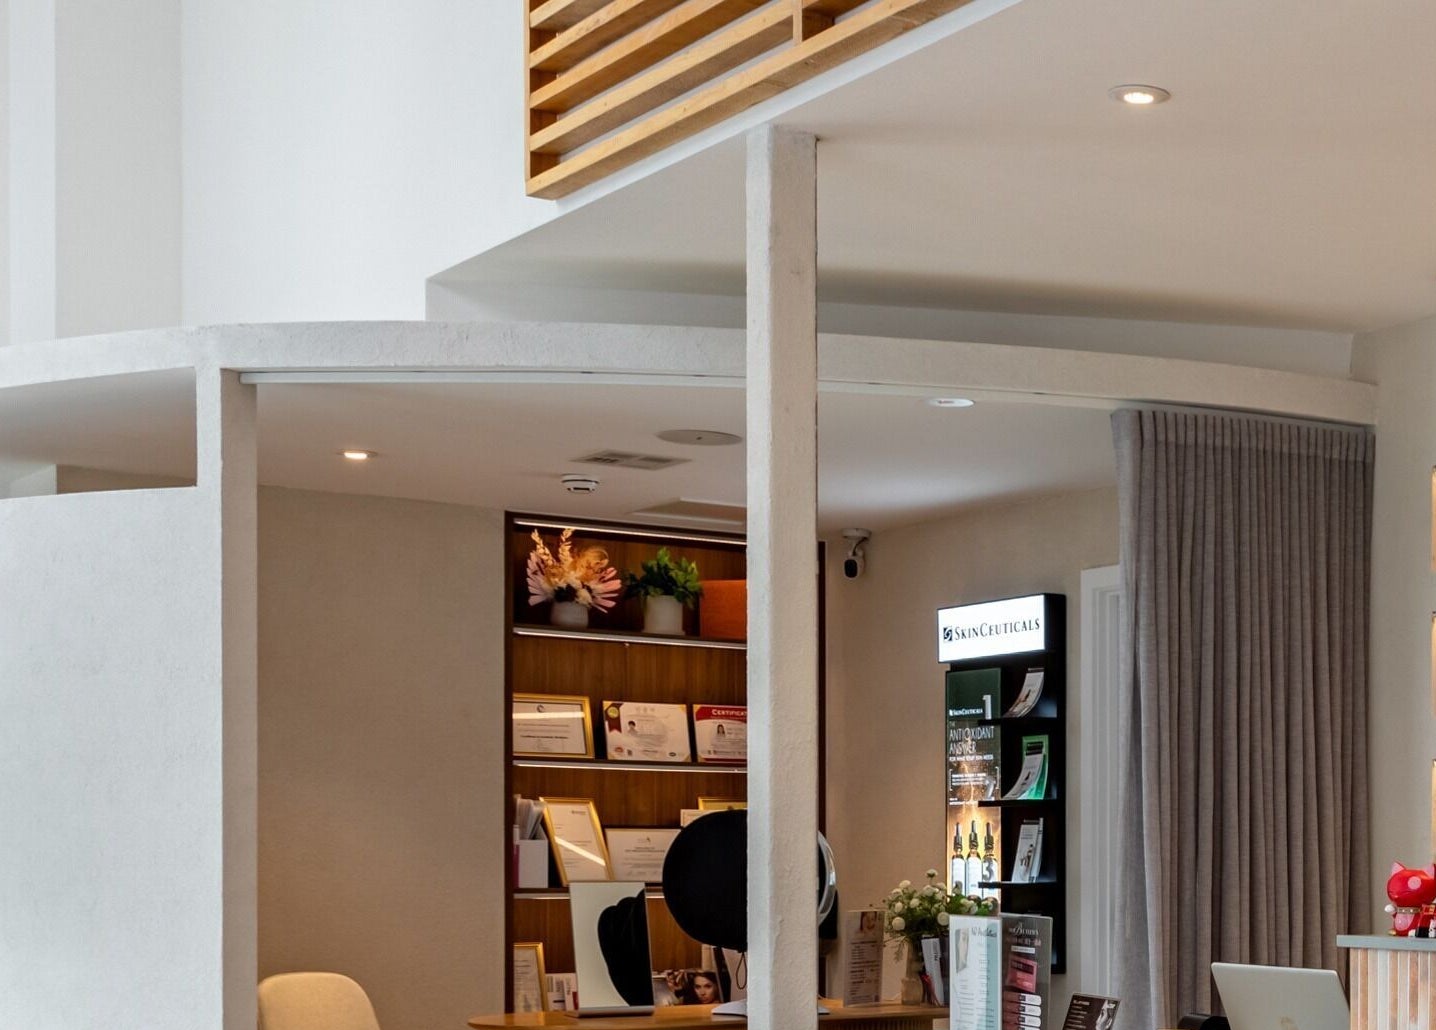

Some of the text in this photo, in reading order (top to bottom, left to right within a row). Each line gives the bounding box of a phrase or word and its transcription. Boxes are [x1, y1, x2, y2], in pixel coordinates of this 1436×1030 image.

[711, 709, 747, 717] CERTIFICA
[949, 726, 994, 741] ANTIOXIDANT
[949, 741, 977, 755] ANSWER
